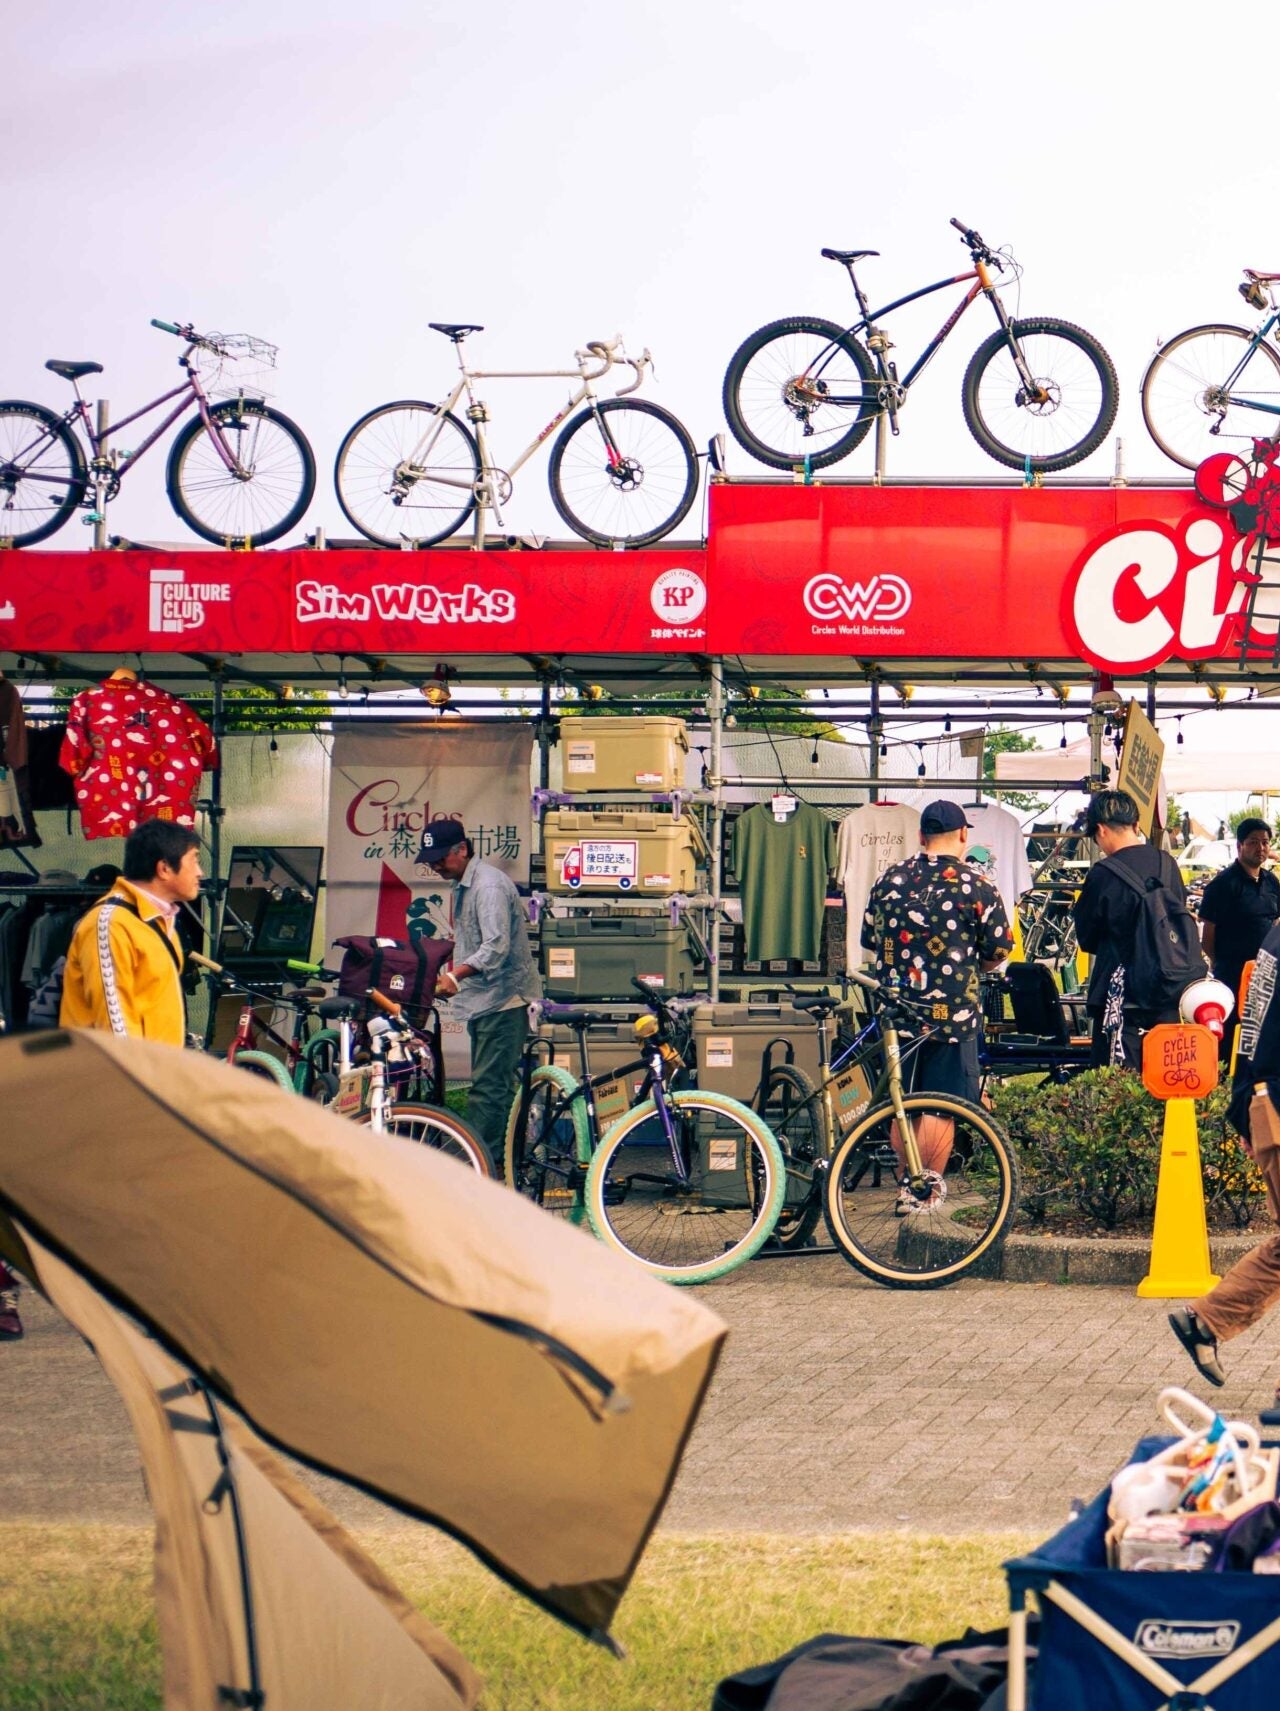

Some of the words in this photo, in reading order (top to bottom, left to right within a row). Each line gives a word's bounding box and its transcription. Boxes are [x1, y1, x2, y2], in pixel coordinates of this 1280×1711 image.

[163, 583, 231, 601] CULTURE
[662, 586, 695, 607] KP
[803, 573, 912, 621] CWD
[163, 601, 204, 622] CLUB
[812, 625, 836, 634] Circles
[839, 625, 860, 635] World
[862, 625, 905, 635] Distribution
[389, 824, 522, 860] 森市場
[861, 831, 904, 847] Circles
[586, 853, 632, 864] 後日配送も
[1163, 1035, 1197, 1053] CYCLE
[1163, 1049, 1197, 1067] CLOAK
[1142, 1624, 1216, 1651] Coleman
